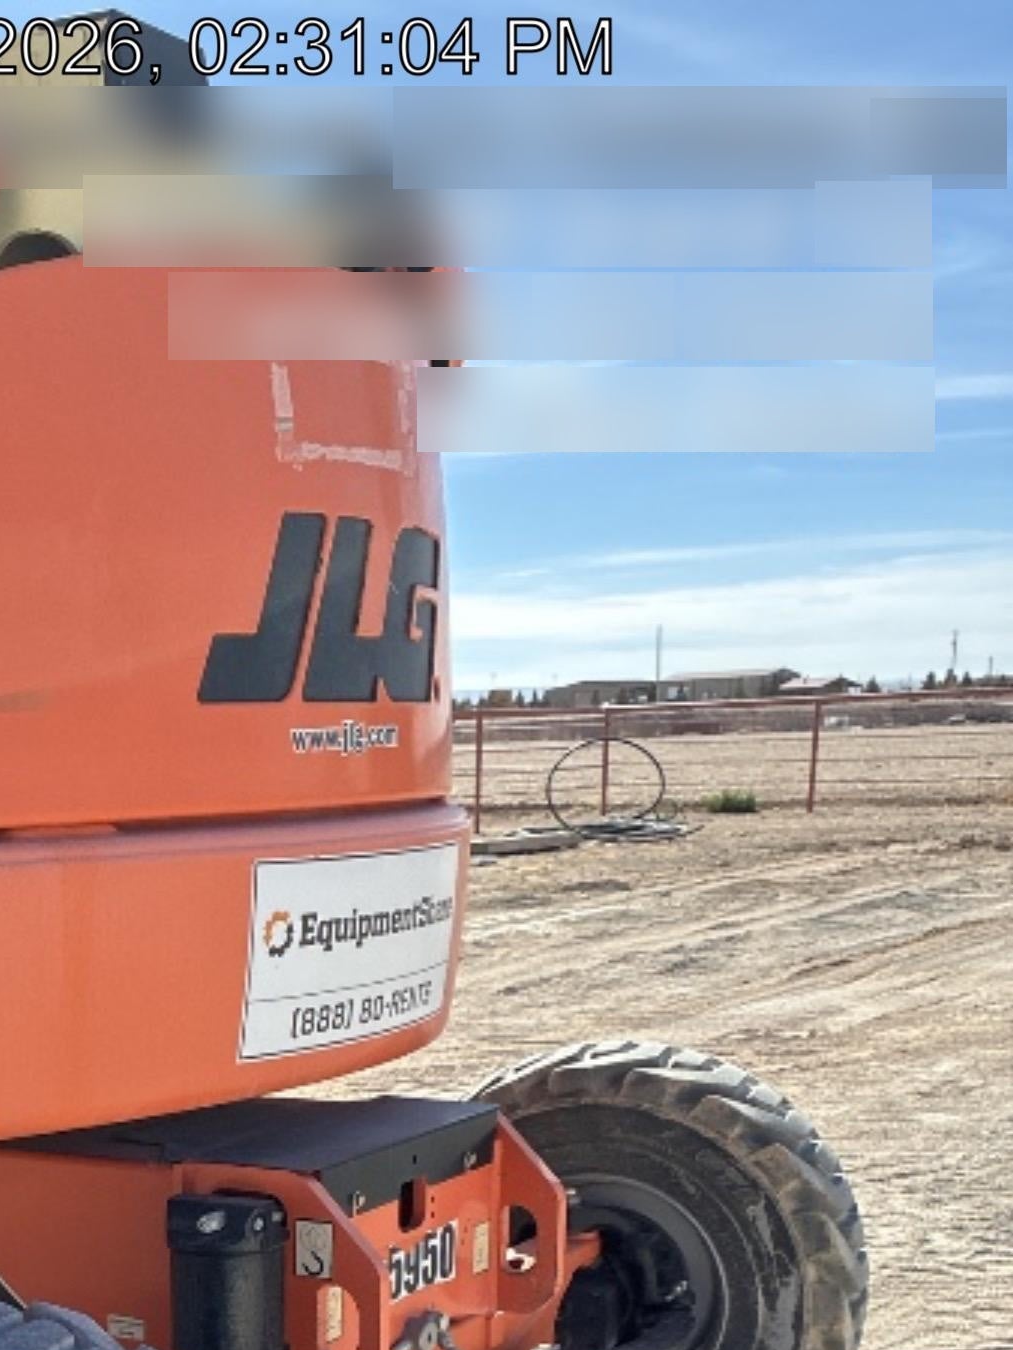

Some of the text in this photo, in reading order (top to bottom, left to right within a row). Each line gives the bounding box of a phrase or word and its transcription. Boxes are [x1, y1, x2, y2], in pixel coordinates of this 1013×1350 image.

[196, 511, 440, 704] JLG
[291, 720, 399, 754] www.jlg.com
[291, 998, 354, 1039] (888)
